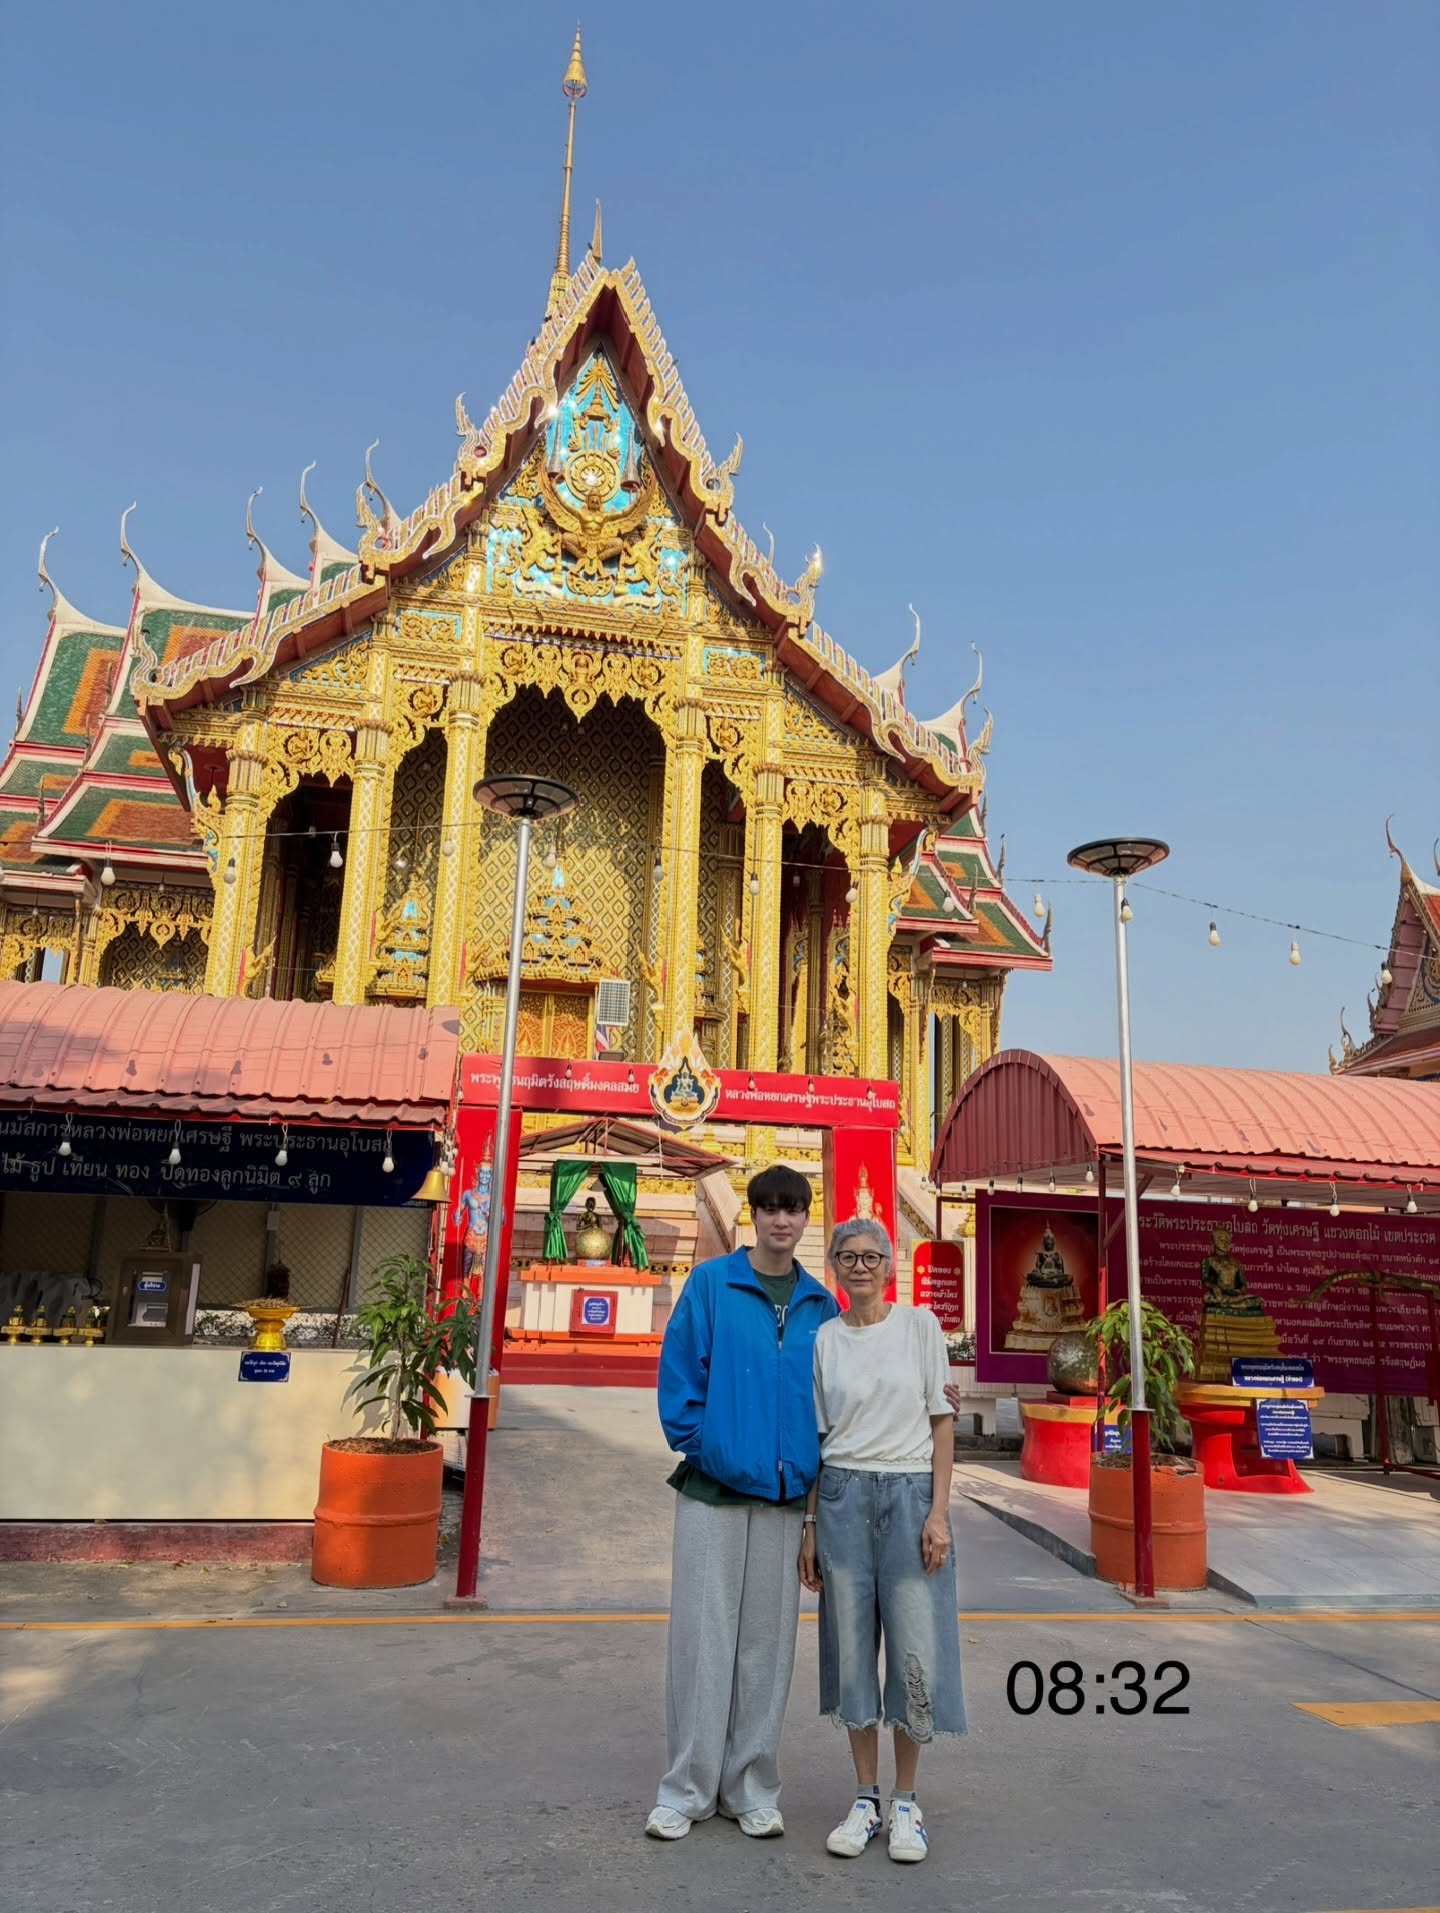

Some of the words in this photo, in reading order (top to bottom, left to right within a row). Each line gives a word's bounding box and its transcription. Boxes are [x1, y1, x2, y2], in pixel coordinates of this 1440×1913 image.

[30, 1156, 56, 1182] ธูป
[62, 1153, 107, 1178] เทียน
[115, 1163, 150, 1180] ทอง
[288, 1172, 302, 1186] ๙
[308, 1173, 330, 1195] ลูก
[1261, 1217, 1320, 1242] วัดทุ่งเศรษฐี
[1323, 1222, 1380, 1241] แขวงดอกไม้
